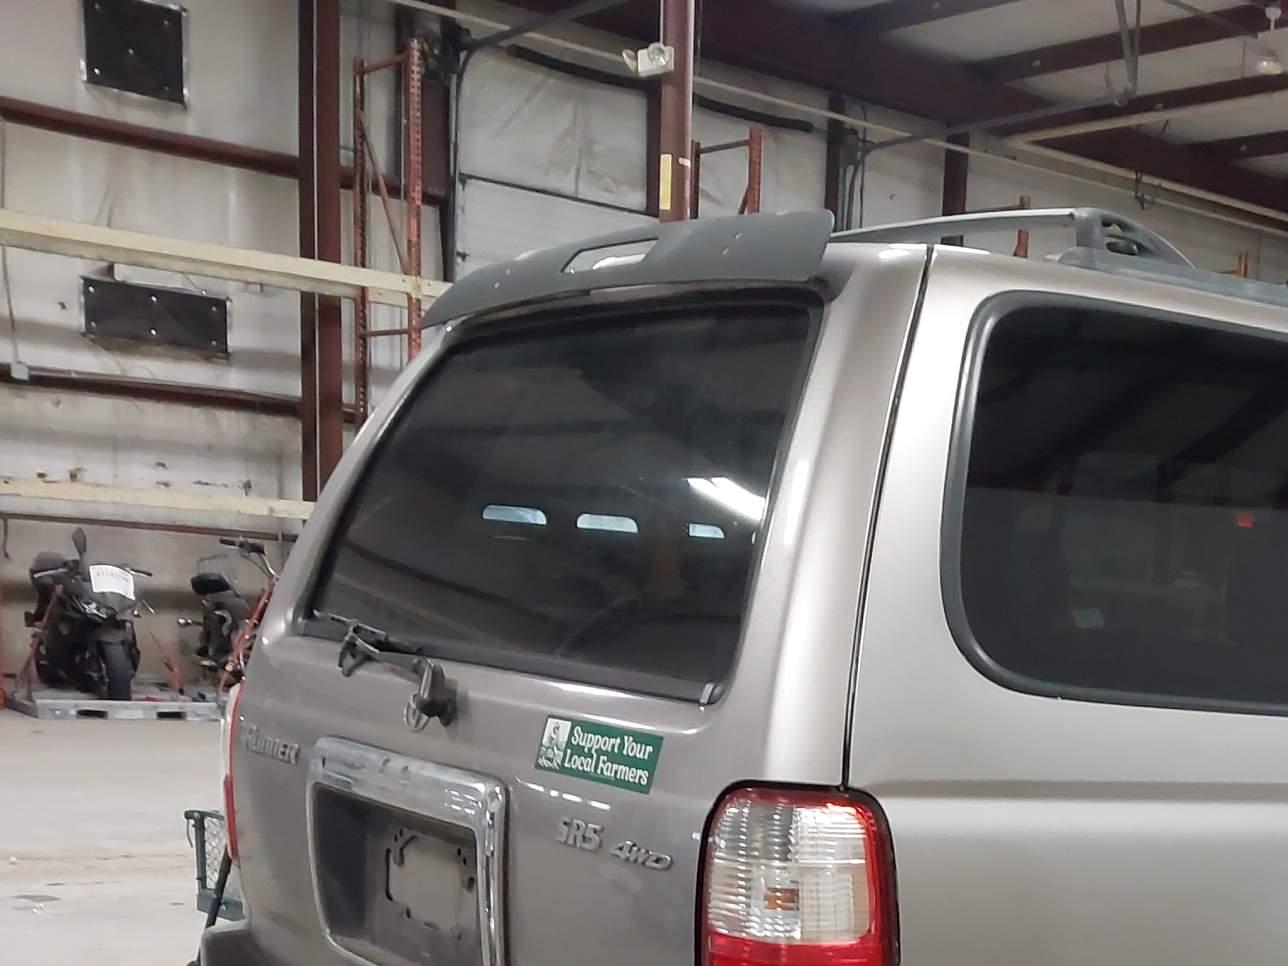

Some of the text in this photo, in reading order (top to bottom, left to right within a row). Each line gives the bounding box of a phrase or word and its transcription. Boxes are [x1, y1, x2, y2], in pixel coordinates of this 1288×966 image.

[571, 725, 654, 760] Support Your
[563, 748, 650, 786] Local Farmers
[556, 817, 604, 851] SR5
[608, 840, 673, 871] 4WD
